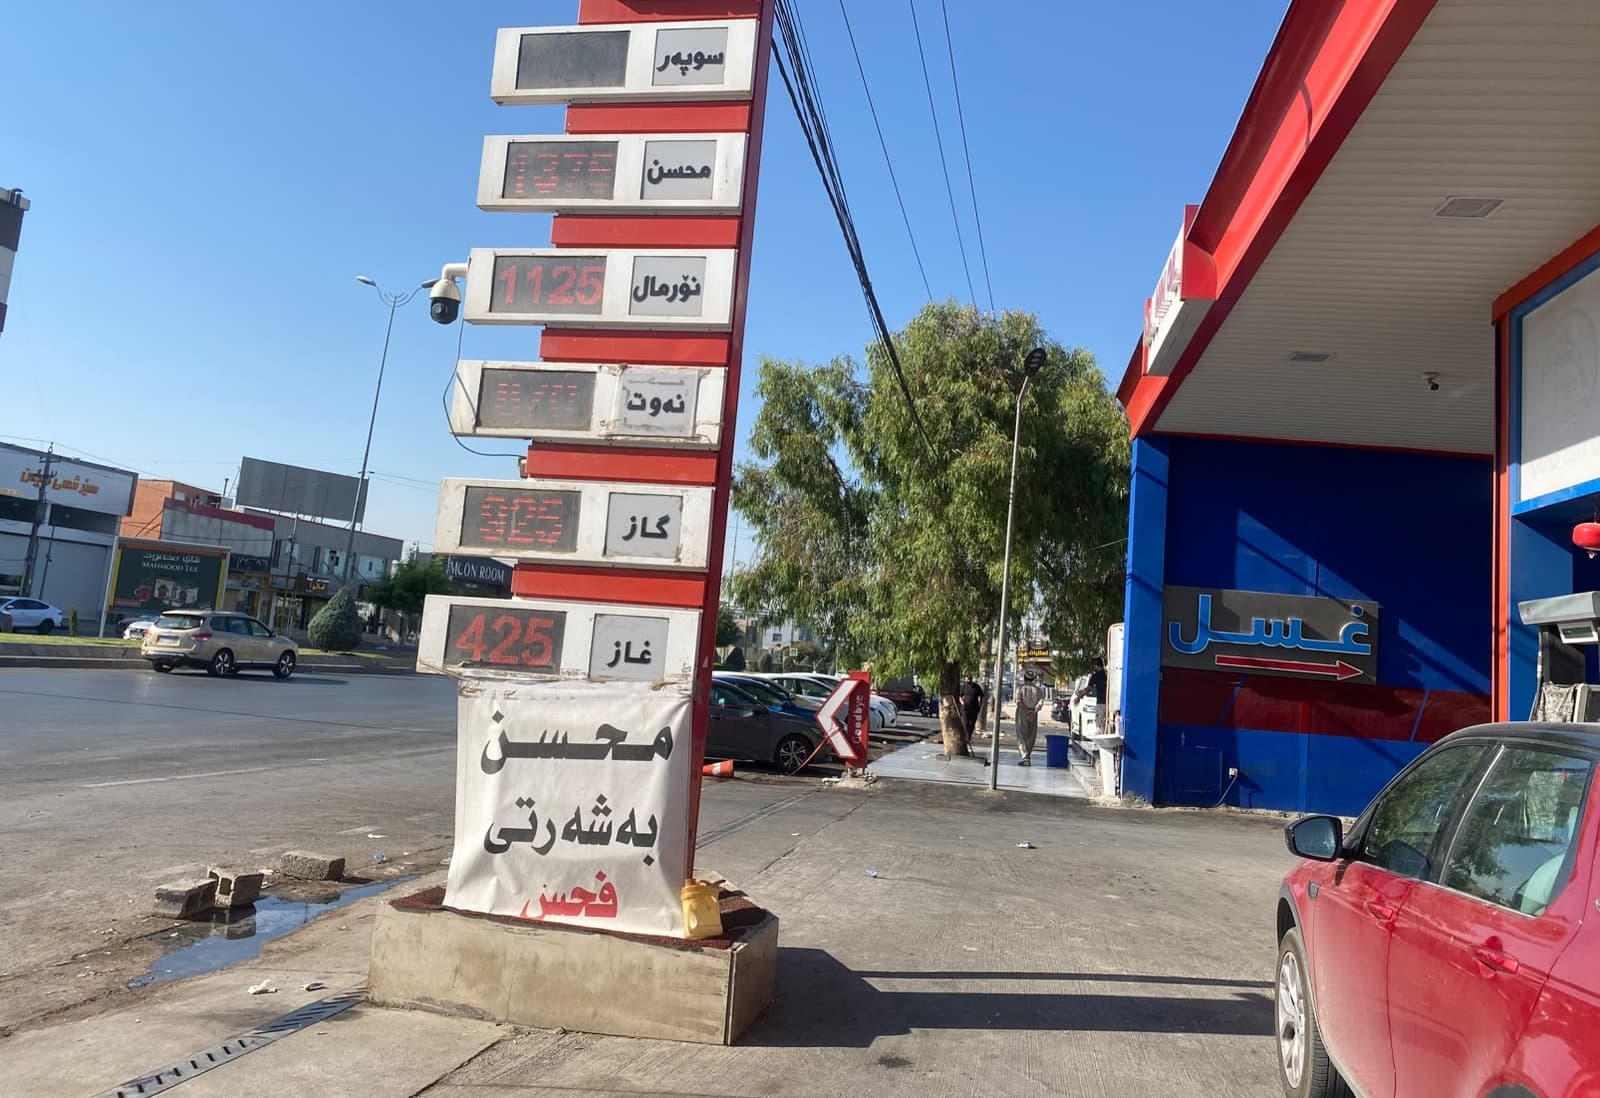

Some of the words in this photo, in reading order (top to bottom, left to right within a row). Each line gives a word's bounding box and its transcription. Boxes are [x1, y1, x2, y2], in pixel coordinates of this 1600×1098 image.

[656, 51, 724, 76] سوپەر
[647, 159, 711, 184] محسن
[497, 264, 606, 306] 1125
[633, 274, 700, 302] نۆرمال
[627, 391, 685, 417] نەوت
[622, 514, 670, 541] گاز
[141, 561, 184, 572] MAHMOOD
[480, 566, 504, 582] ROOM
[1169, 594, 1371, 655] غسل
[455, 613, 555, 667] 425
[606, 640, 651, 668] غاز
[852, 695, 863, 744] Goodbye
[480, 710, 673, 775] محسن
